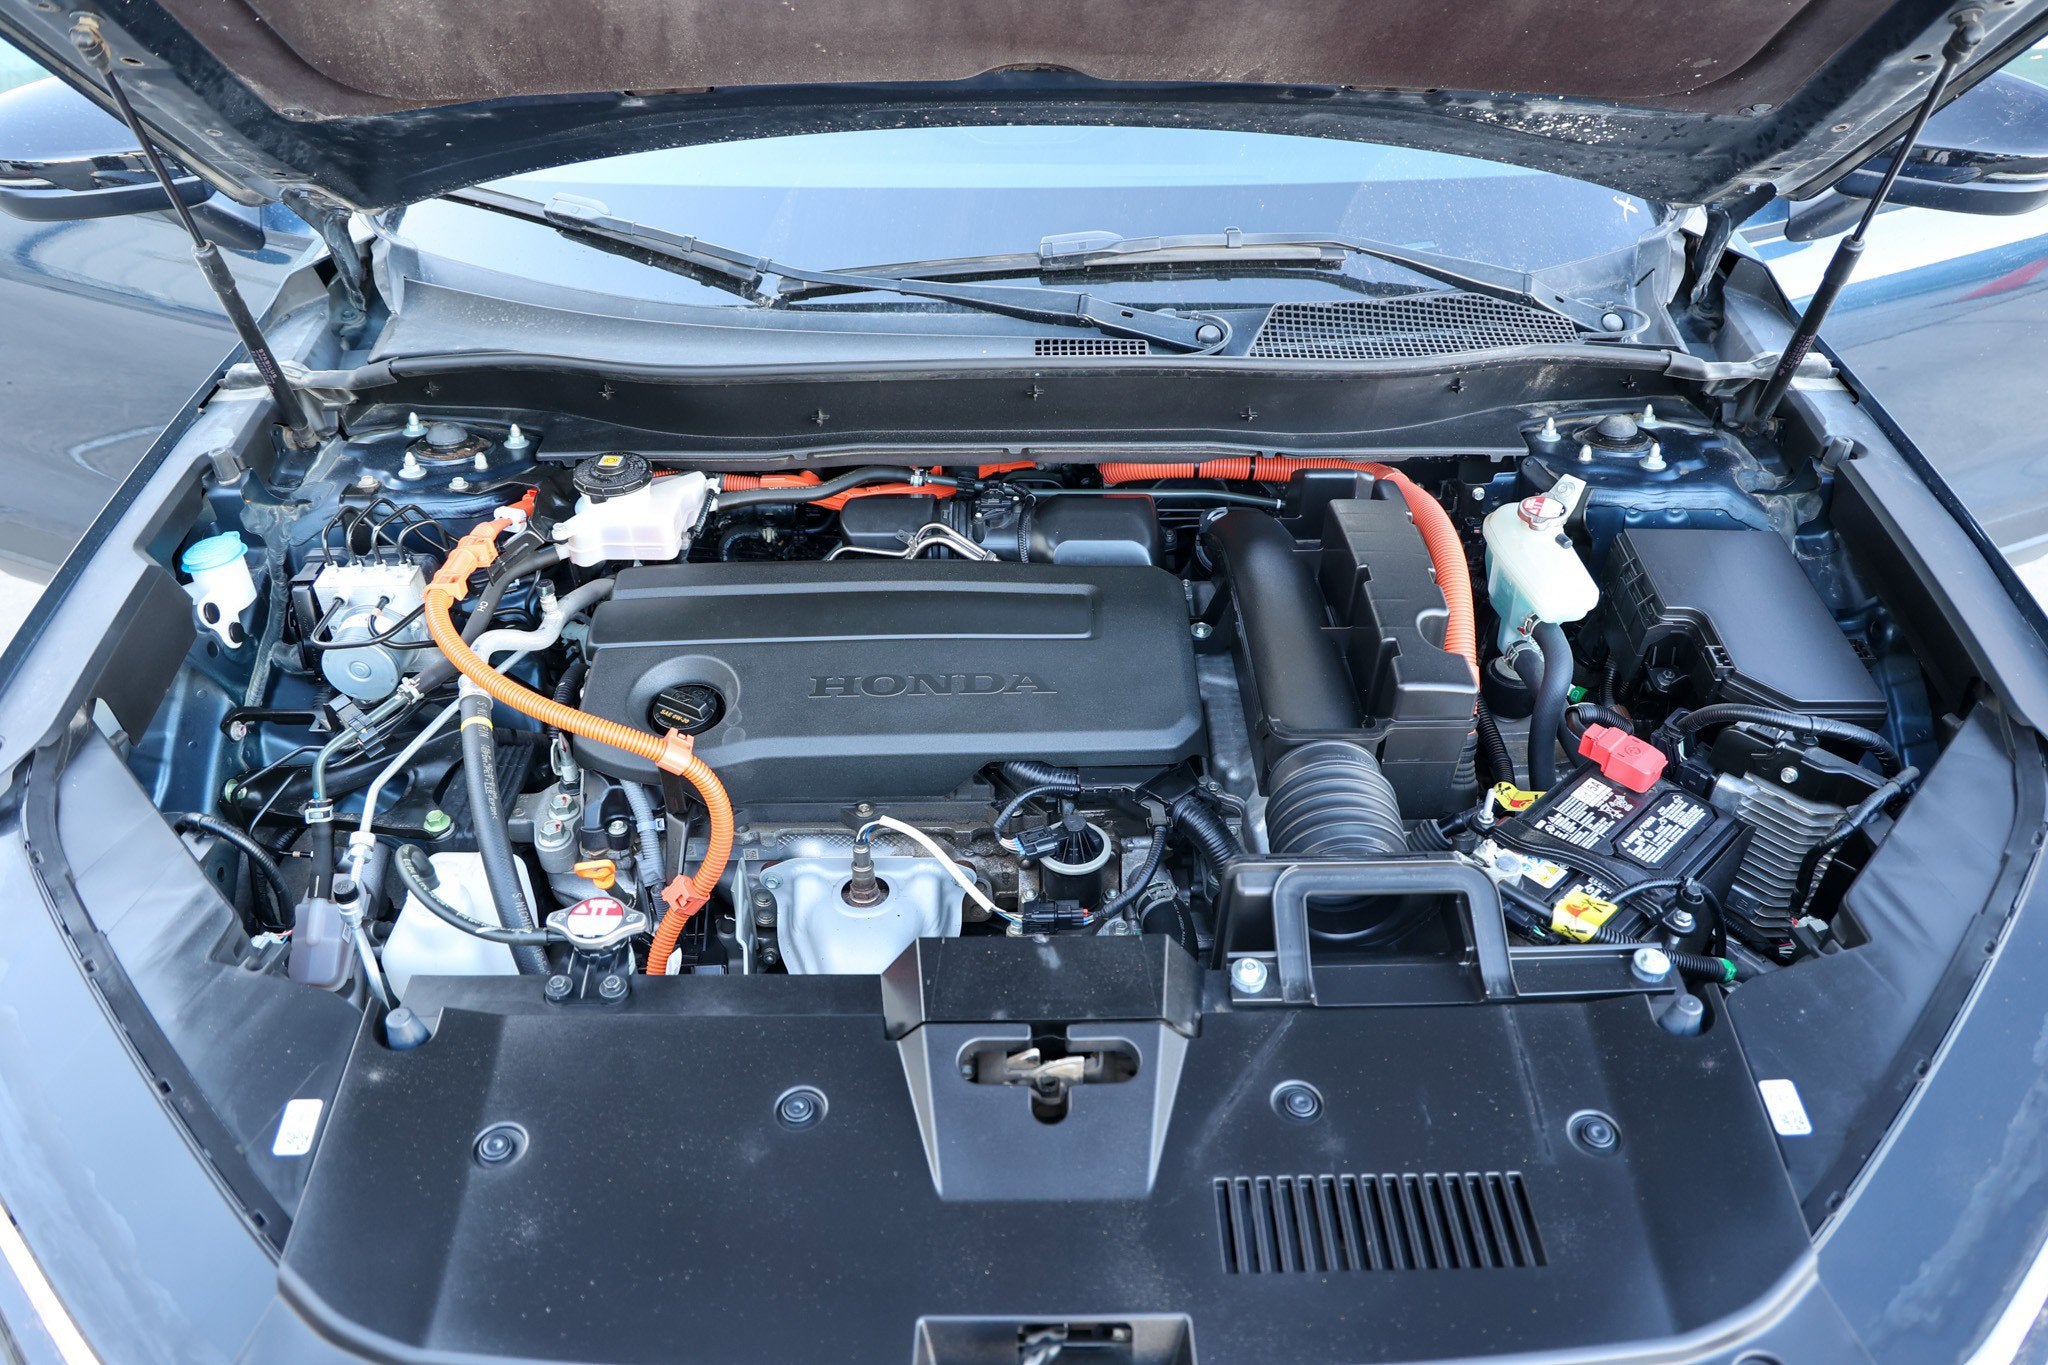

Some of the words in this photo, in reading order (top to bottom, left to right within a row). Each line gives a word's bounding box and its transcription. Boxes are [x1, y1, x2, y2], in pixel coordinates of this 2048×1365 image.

[258, 348, 278, 379] STABILUS
[808, 673, 1058, 698] HONDA
[660, 709, 673, 717] SAE
